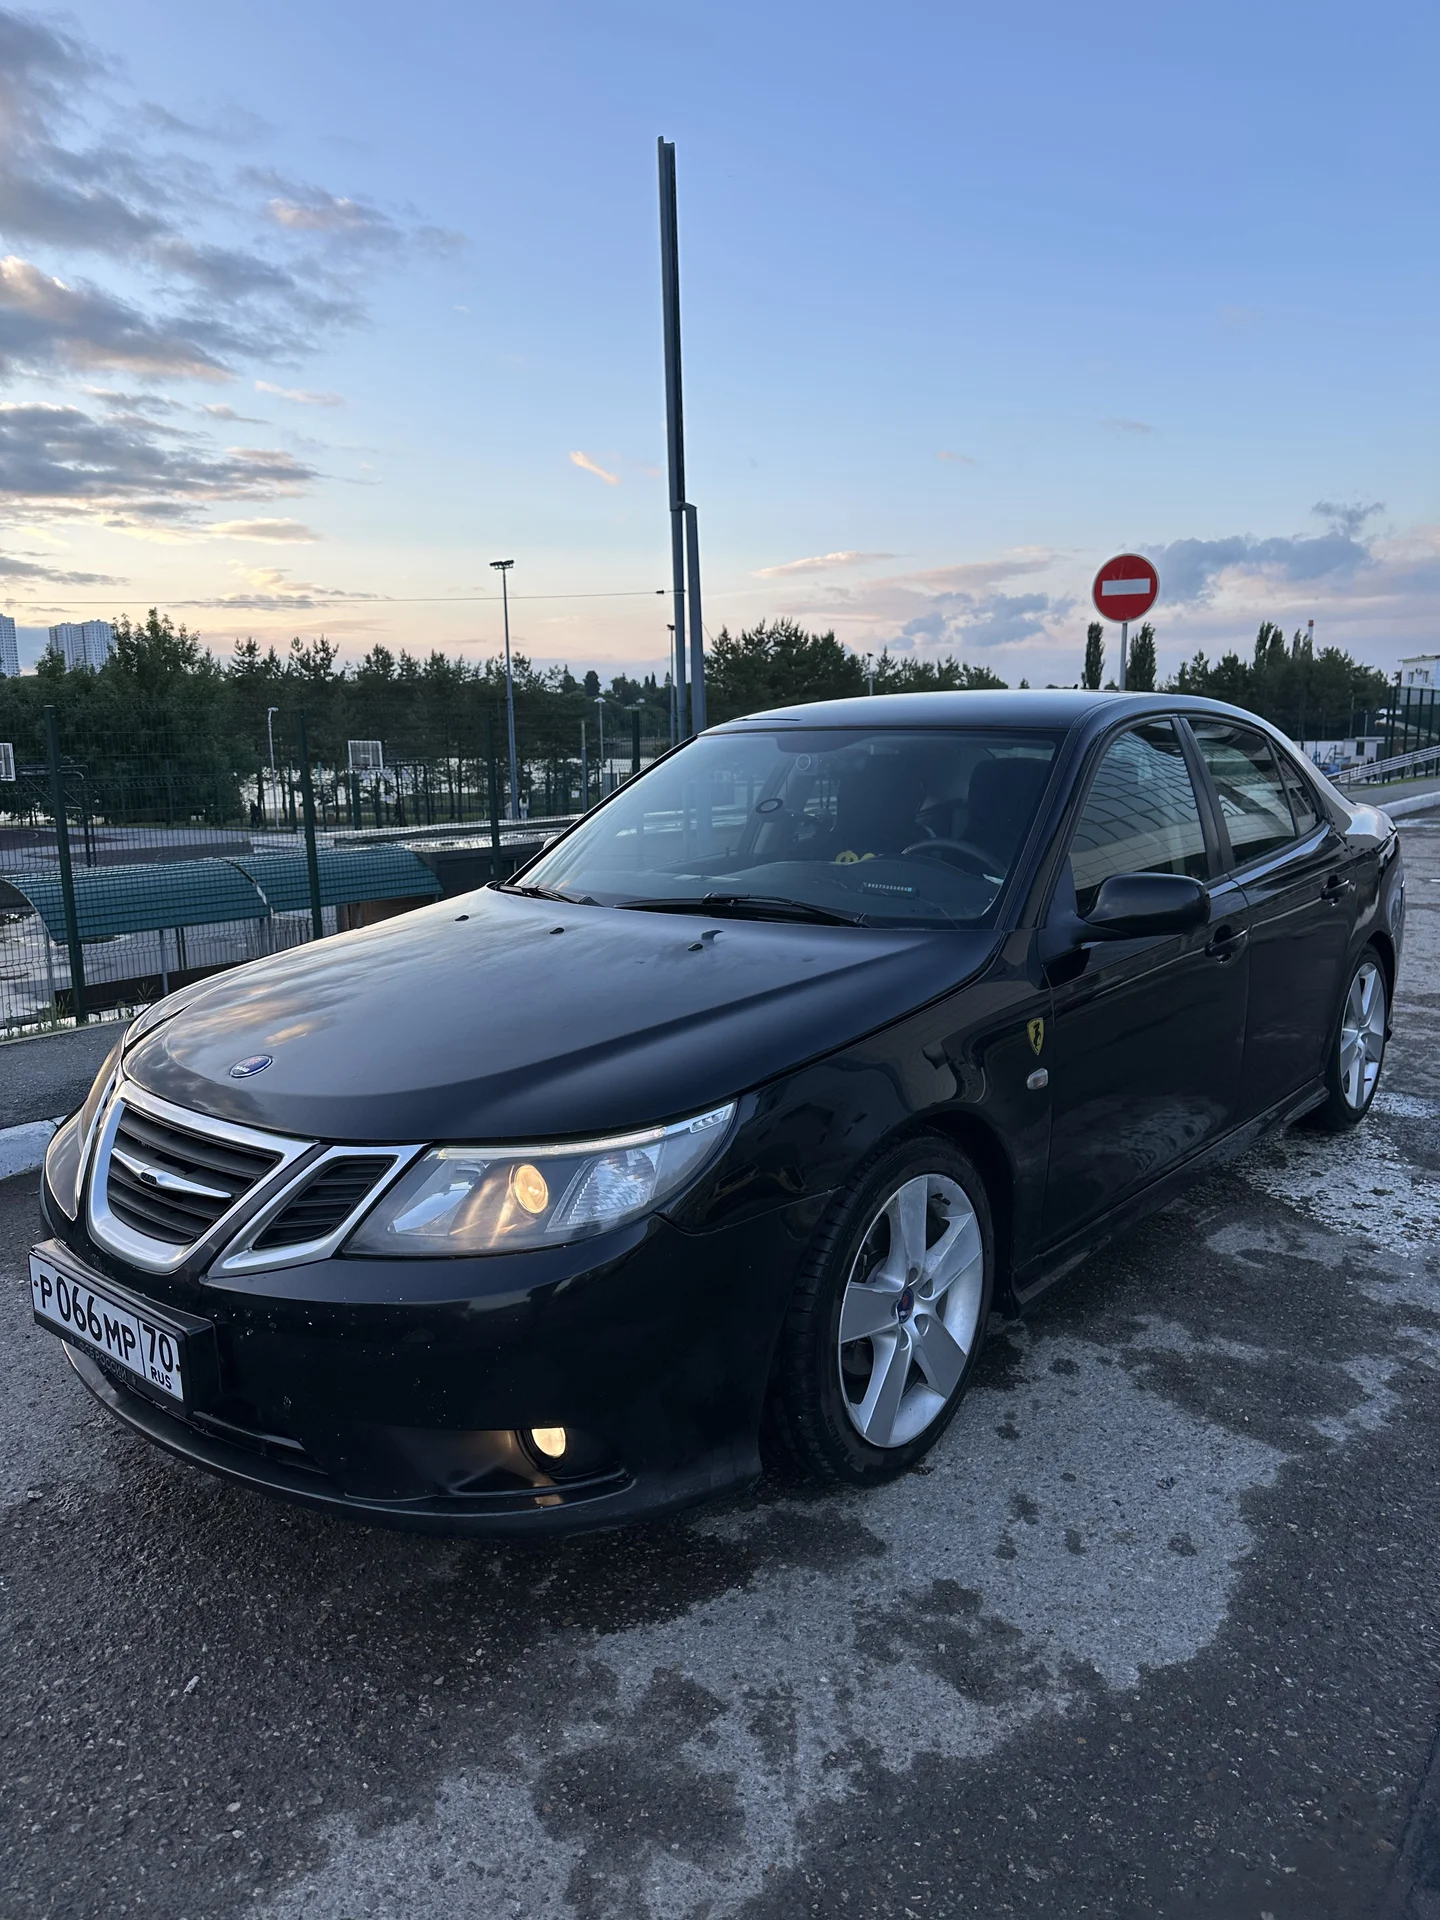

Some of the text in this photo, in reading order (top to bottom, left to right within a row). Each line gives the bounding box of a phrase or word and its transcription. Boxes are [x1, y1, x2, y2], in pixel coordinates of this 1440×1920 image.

[143, 1323, 173, 1373] 70
[95, 1351, 127, 1380] РОССИИ
[150, 1367, 172, 1390] RUS
